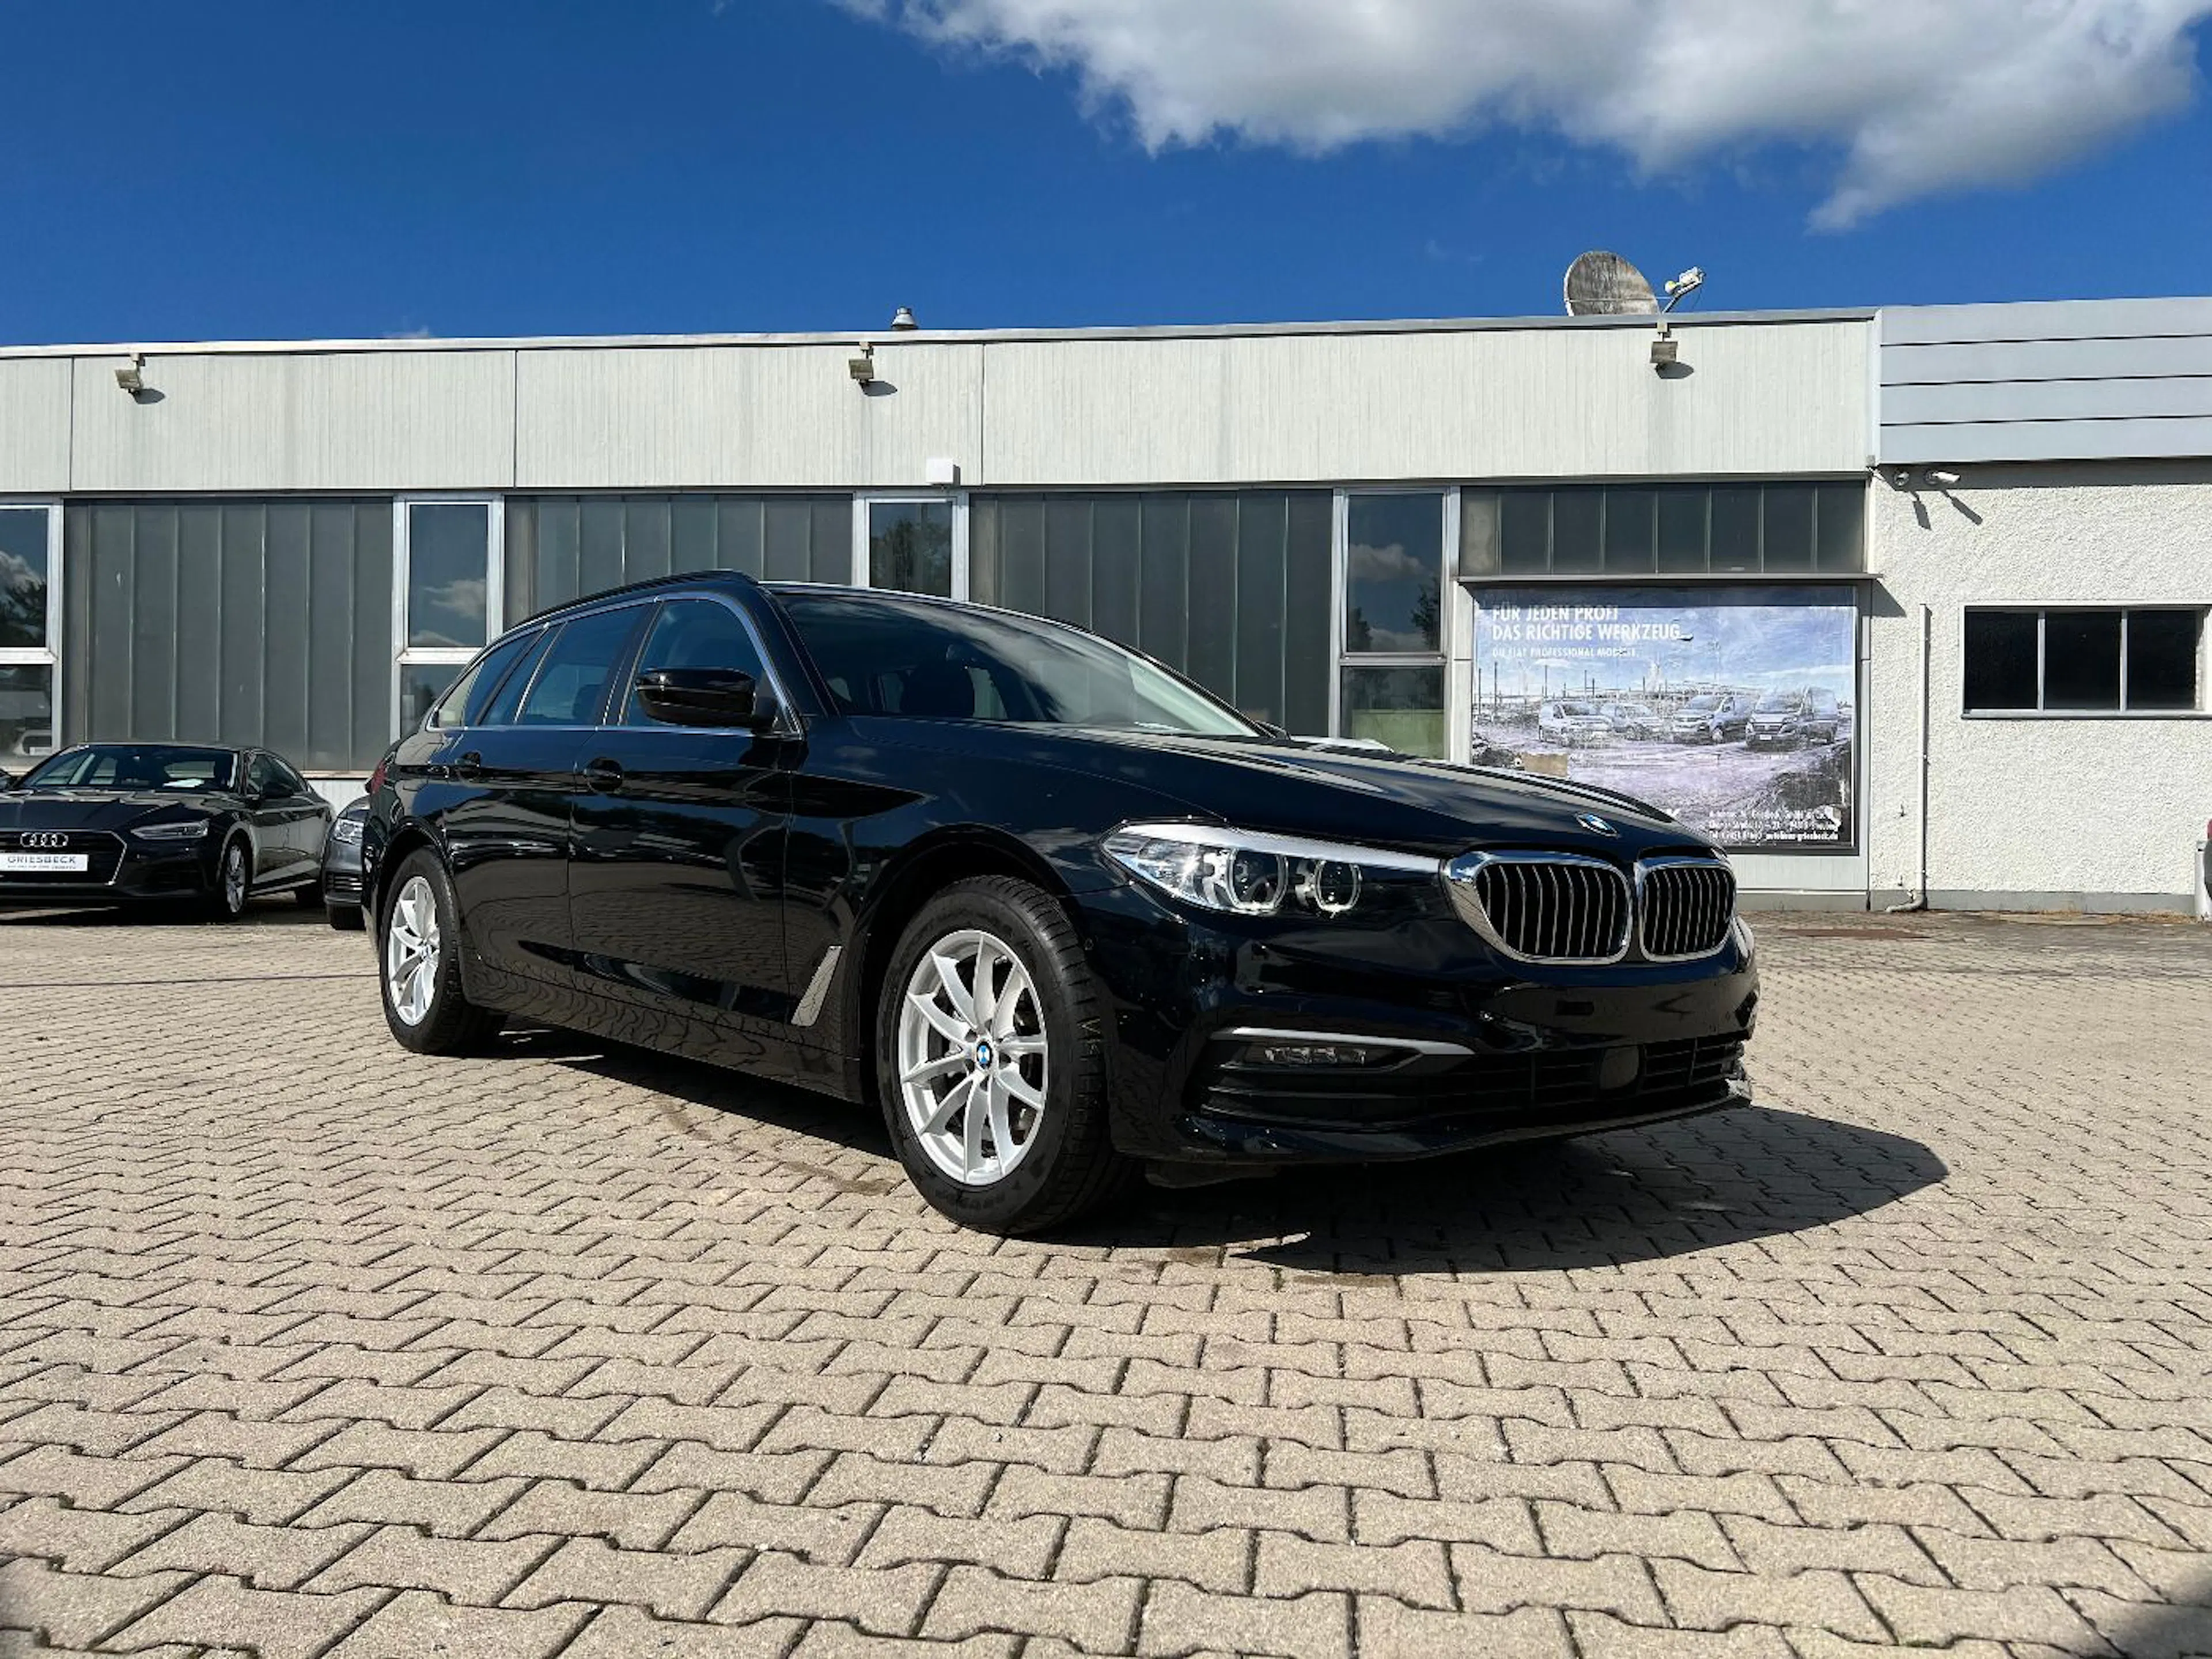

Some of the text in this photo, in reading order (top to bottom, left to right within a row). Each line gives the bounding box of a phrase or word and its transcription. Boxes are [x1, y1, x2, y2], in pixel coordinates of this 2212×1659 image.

[1492, 602, 1619, 621] FÜR JEDEN PROFI
[1492, 624, 1521, 641] DAS
[1526, 623, 1593, 641] RICHTIGE
[1530, 647, 1594, 657] PROFESSIONAL
